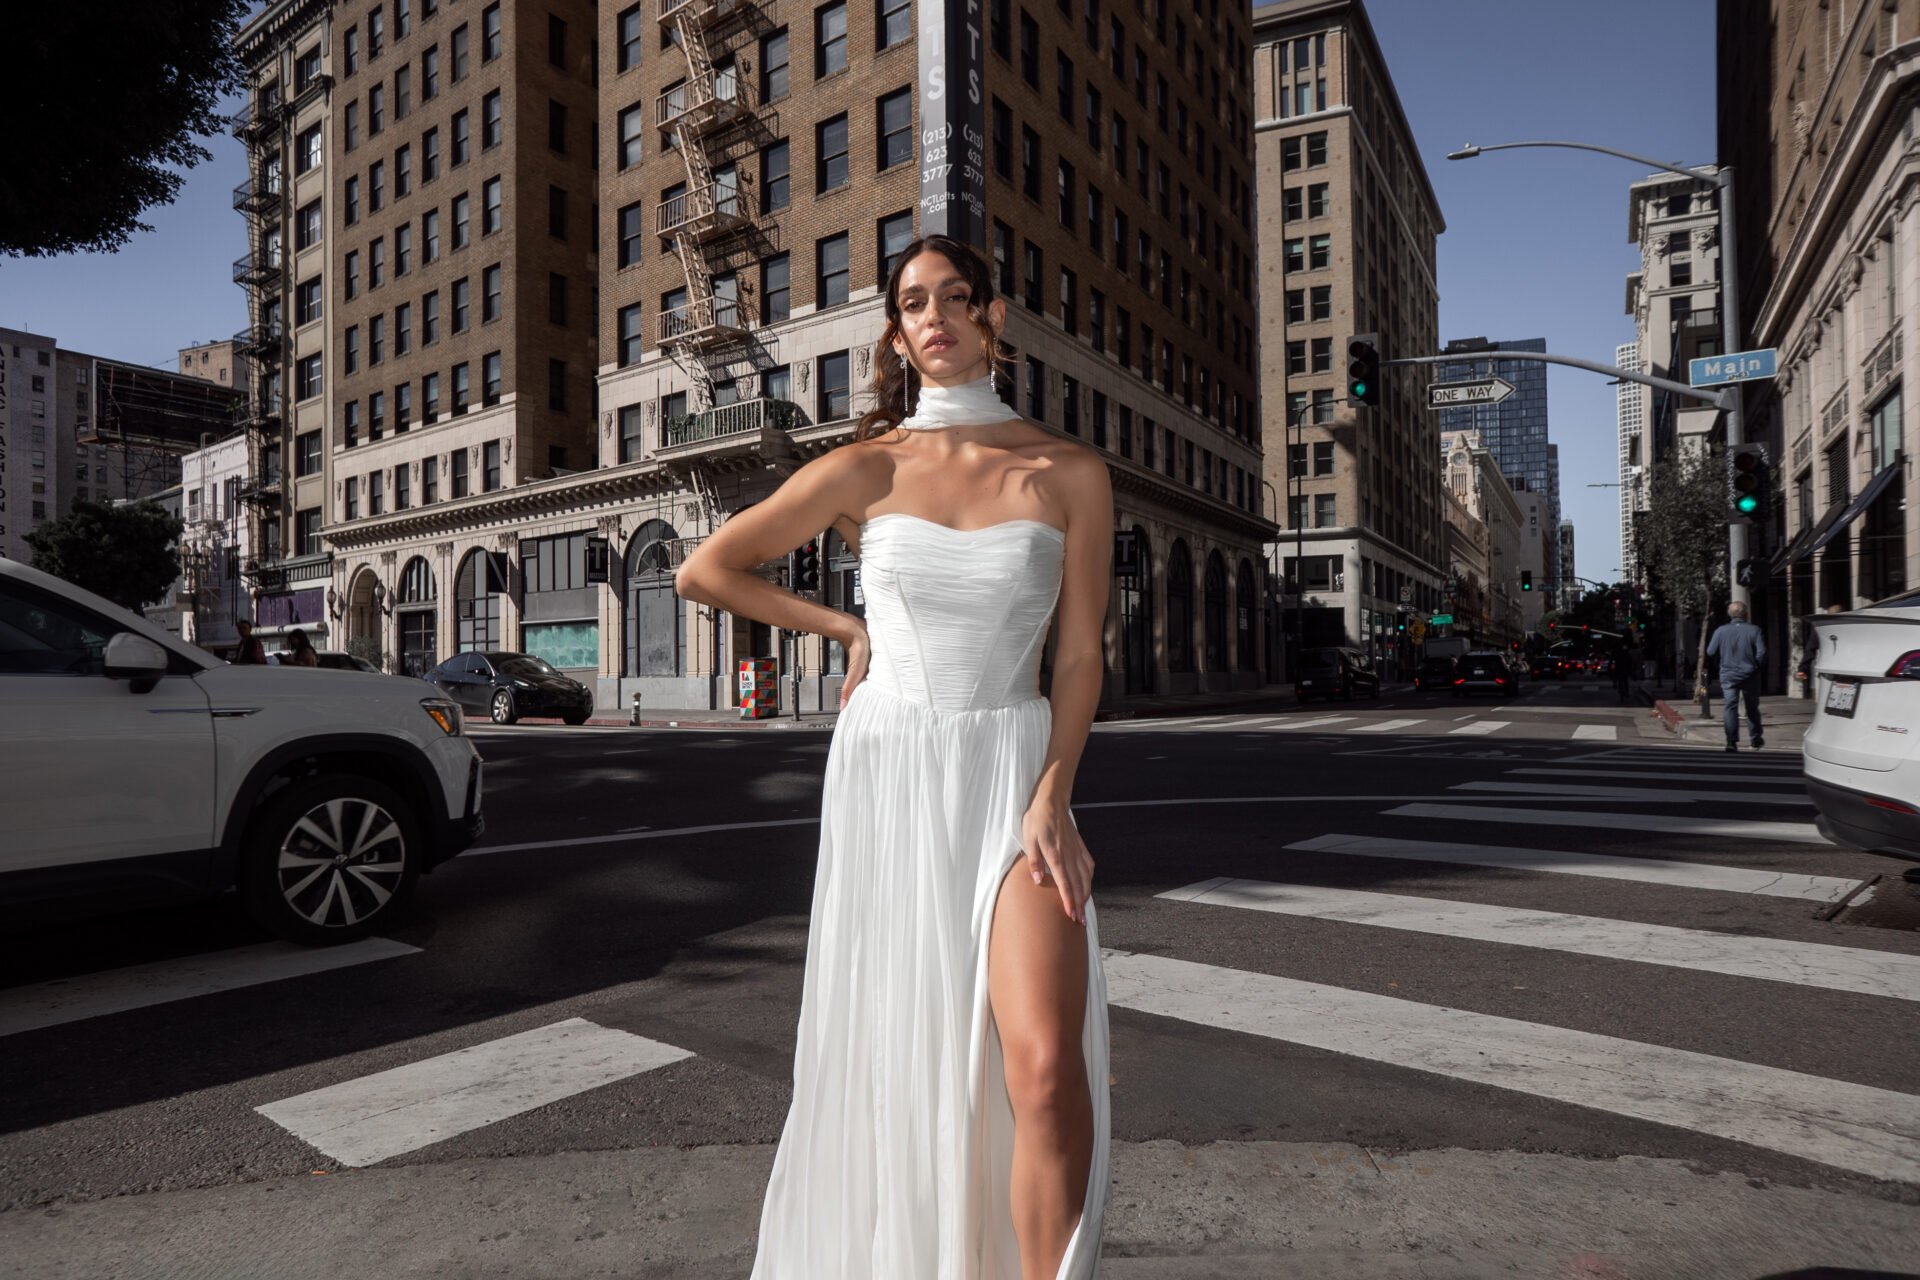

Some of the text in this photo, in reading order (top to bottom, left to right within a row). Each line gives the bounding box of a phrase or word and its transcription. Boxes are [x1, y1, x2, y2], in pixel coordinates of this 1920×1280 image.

[922, 121, 952, 147] (213)
[963, 123, 983, 151] (213)
[926, 145, 948, 163] 623
[967, 148, 982, 168] 623
[922, 163, 953, 184] 3777
[963, 164, 983, 187] 3777
[920, 191, 956, 208] NCTLofts
[927, 201, 947, 215] .com
[1704, 358, 1761, 377] Main
[1434, 386, 1493, 402] ONE WAY
[589, 541, 606, 569] T
[1117, 535, 1136, 563] T
